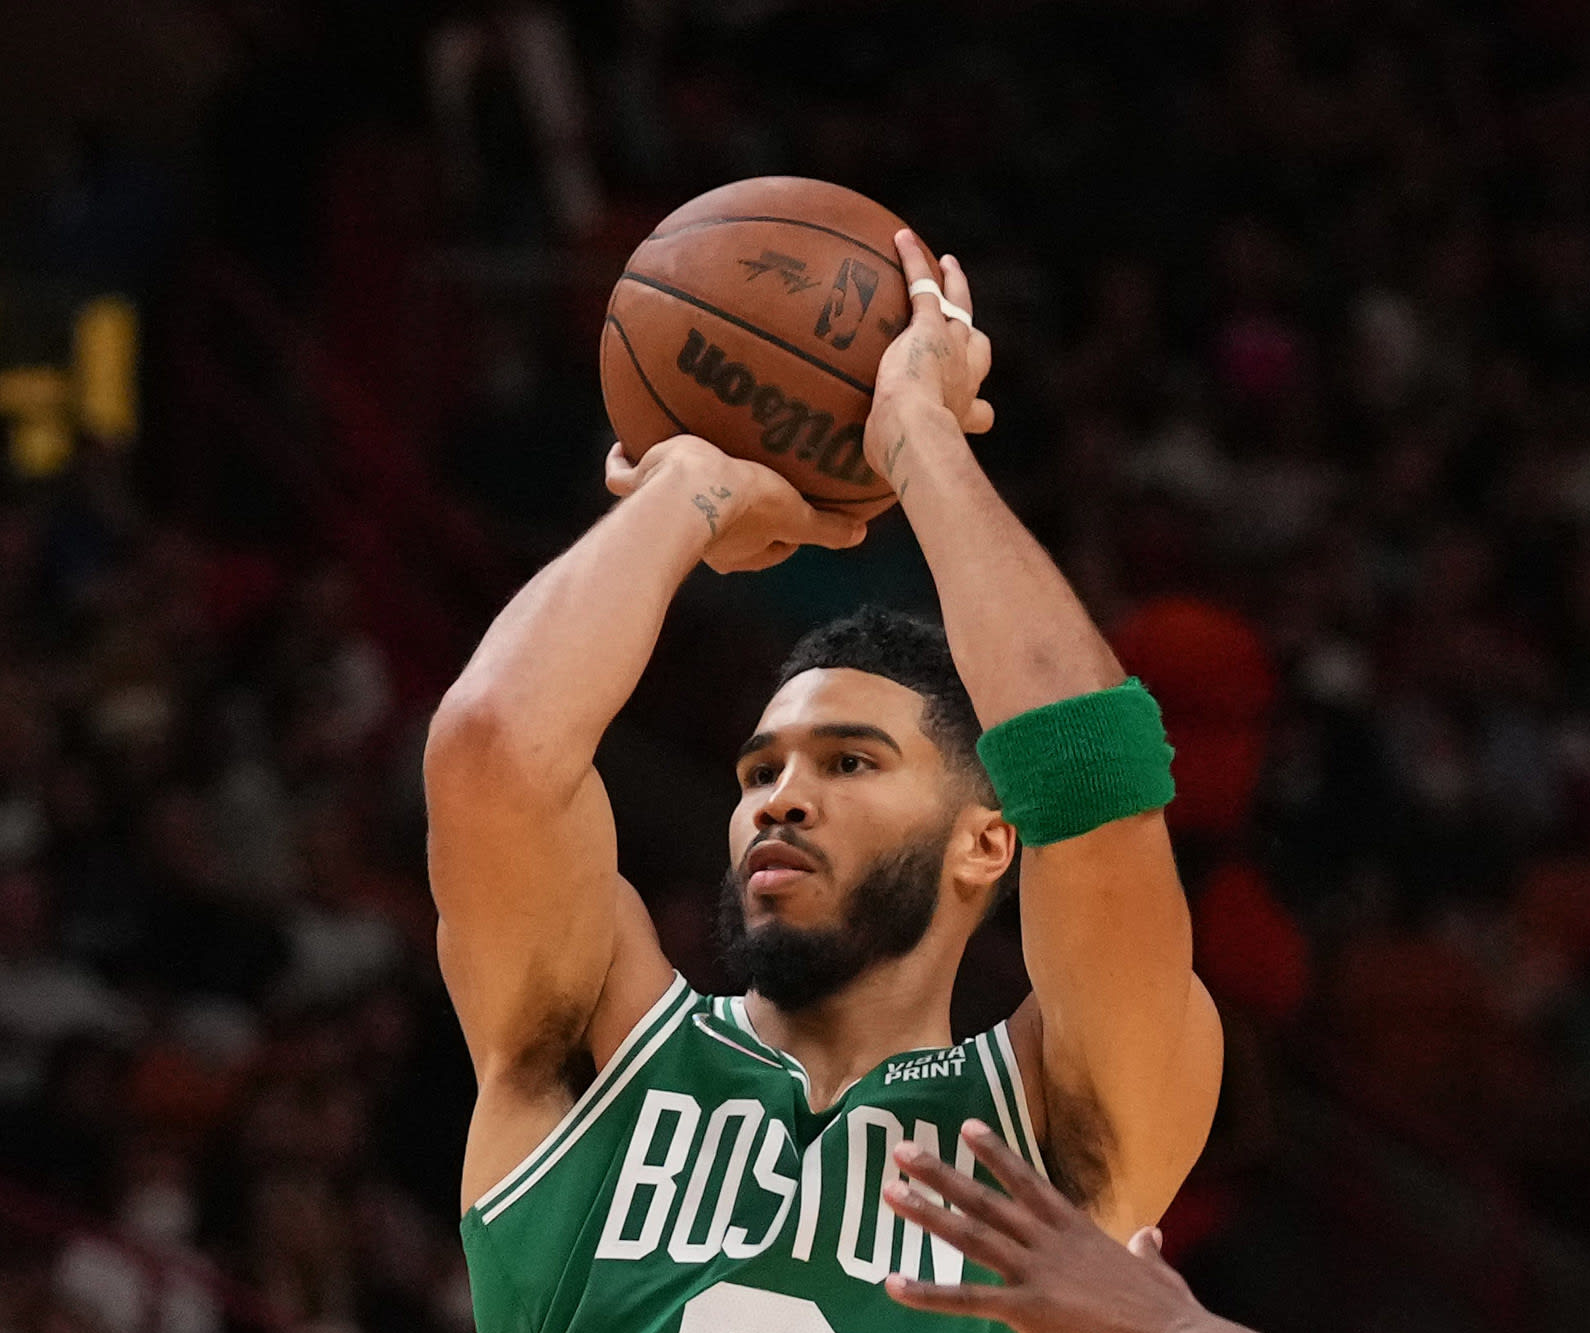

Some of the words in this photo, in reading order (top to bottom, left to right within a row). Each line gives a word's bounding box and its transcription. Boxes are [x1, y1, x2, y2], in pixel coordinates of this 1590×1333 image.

[677, 328, 876, 486] Wilson
[885, 1058, 966, 1085] PRINT
[595, 1089, 976, 1287] BOSTON
